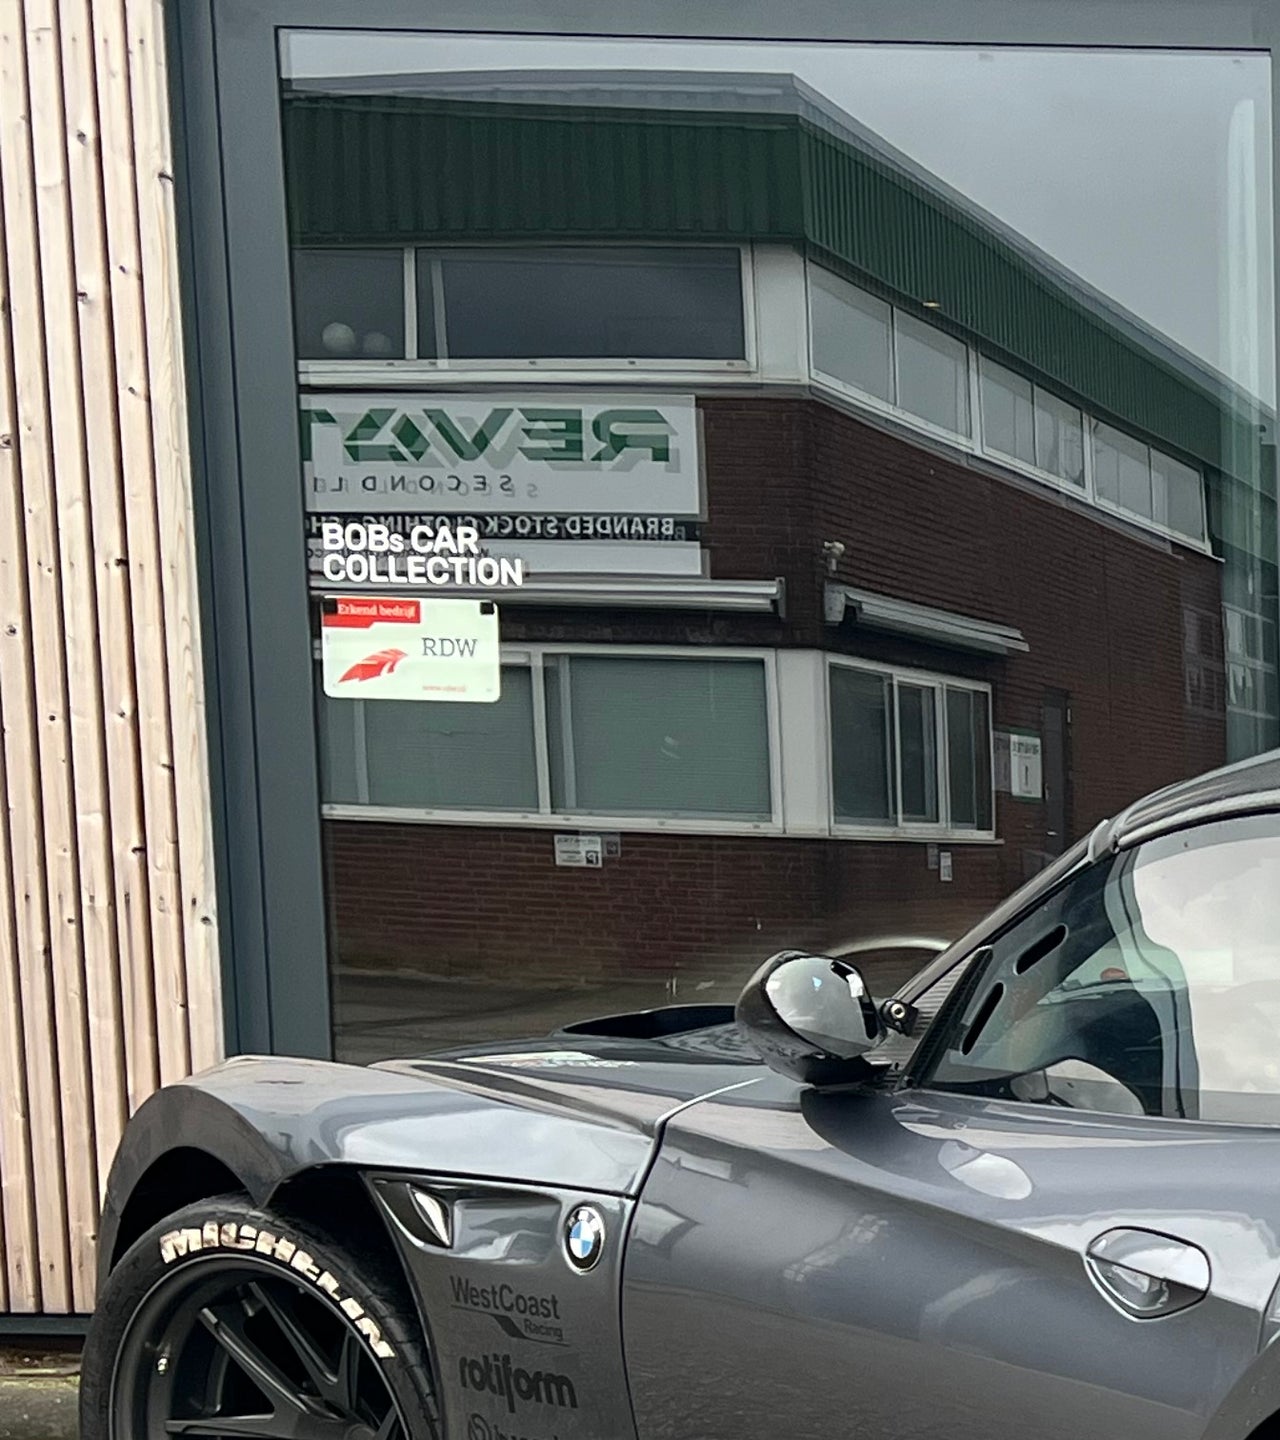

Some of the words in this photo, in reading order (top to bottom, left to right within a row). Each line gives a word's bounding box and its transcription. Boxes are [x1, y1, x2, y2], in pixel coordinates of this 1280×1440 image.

[322, 522, 405, 553] BOBs
[410, 525, 480, 554] CAR
[323, 553, 523, 586] COLLECTION
[338, 603, 378, 617] Erkend
[379, 604, 416, 619] bedrijf
[422, 637, 478, 657] RDW
[160, 1221, 396, 1358] MICHELIN
[451, 1275, 560, 1320] WestCoast
[524, 1318, 563, 1342] Racing
[459, 1353, 578, 1413] rotiform
